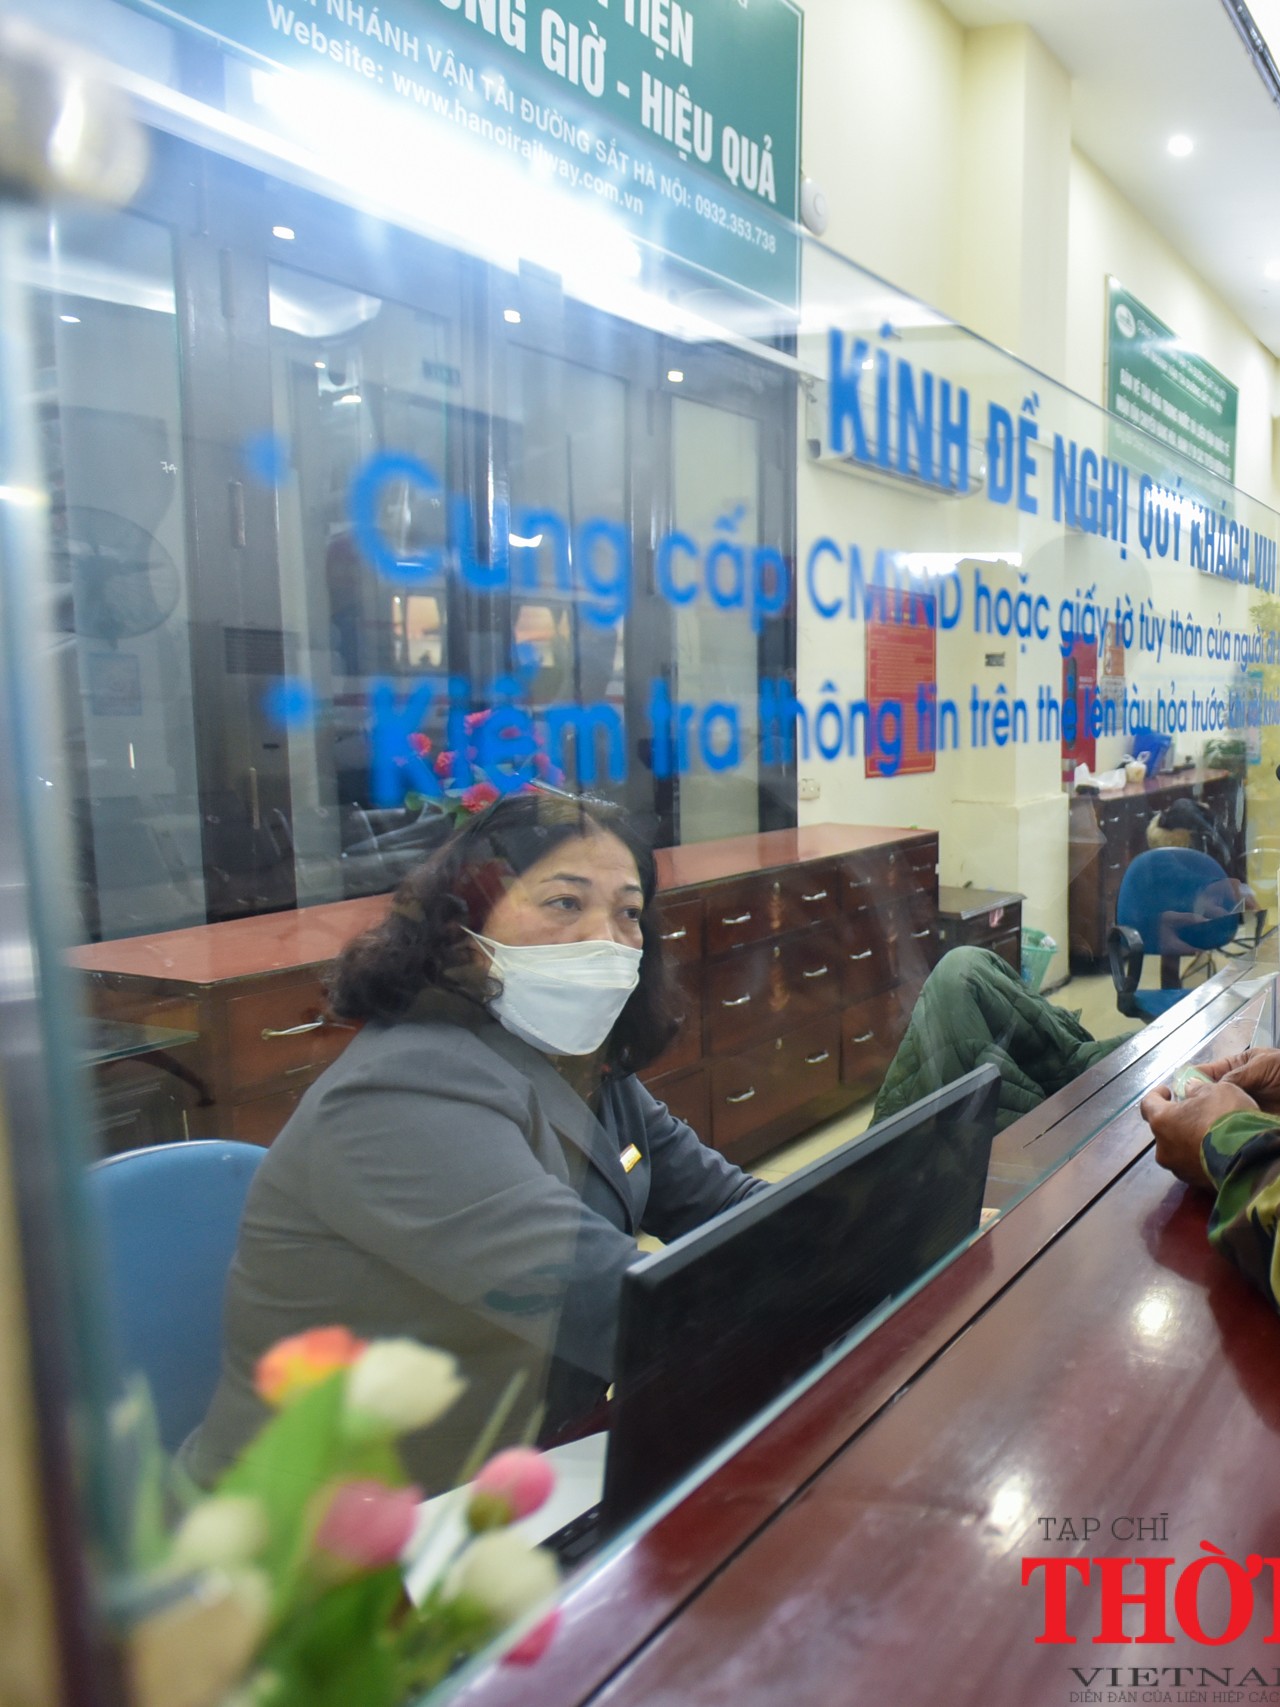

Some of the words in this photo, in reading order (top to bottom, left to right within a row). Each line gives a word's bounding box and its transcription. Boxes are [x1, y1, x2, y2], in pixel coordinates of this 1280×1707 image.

[267, 0, 385, 84] Website:
[392, 70, 644, 216] www.hanoirailway.com.vn
[427, 44, 475, 92] VẬN
[481, 75, 515, 114] TẢI
[521, 97, 590, 155] ĐƯỜNG
[595, 138, 630, 175] SẮT
[633, 160, 657, 190] HÀ
[694, 194, 777, 254] 0932.353.738
[541, 7, 607, 98] GIỜ
[641, 70, 713, 163] HIỆU
[722, 125, 776, 204] QUẢ
[827, 322, 969, 494] KÍNH
[986, 390, 1040, 515] ĐỀ
[1052, 431, 1129, 560] NGHỊ
[1138, 473, 1185, 562] QUÝ
[1190, 500, 1250, 586] KHÁCH
[1254, 532, 1277, 595] VUI
[656, 504, 792, 636] cấp
[973, 566, 1051, 653] hoặc
[1059, 583, 1110, 658] giấy
[1115, 593, 1135, 649] tờ
[1139, 597, 1167, 663] tùy
[1170, 609, 1203, 657] thân
[1206, 611, 1231, 661] của
[1233, 624, 1264, 673] người
[648, 676, 742, 780] tra
[757, 677, 904, 777] thông
[914, 682, 960, 753] tin
[970, 683, 1030, 748] trên
[1083, 684, 1118, 740] lên
[1122, 683, 1152, 737] tàu
[1157, 680, 1188, 734] hỏa
[1191, 687, 1225, 733] trước
